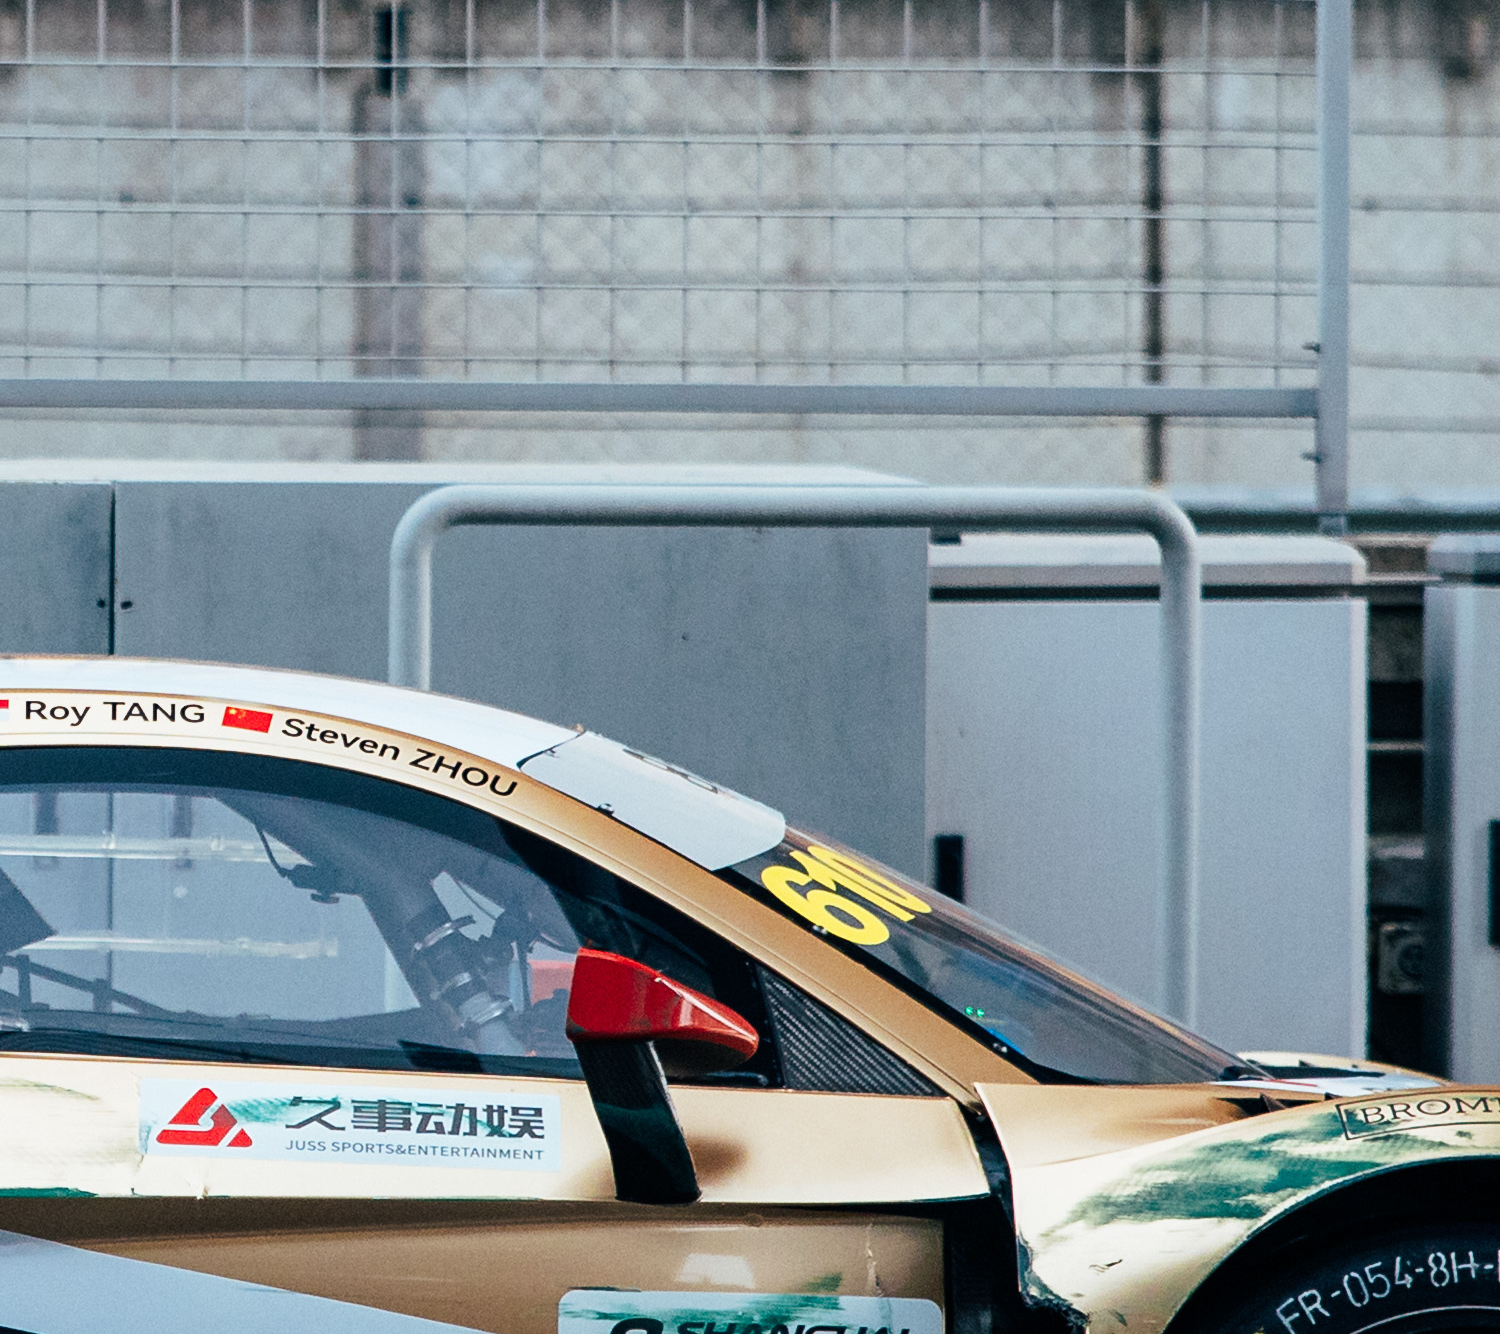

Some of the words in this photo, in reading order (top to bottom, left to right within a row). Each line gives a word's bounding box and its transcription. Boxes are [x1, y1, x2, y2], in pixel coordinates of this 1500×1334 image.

[25, 700, 91, 728] Roy
[103, 701, 206, 724] TANG
[281, 717, 400, 762] Steven
[408, 748, 519, 798] ZHOU
[760, 845, 933, 947] 610
[284, 1096, 545, 1140] 久事动娱
[285, 1139, 328, 1154] JUSS
[330, 1141, 545, 1162] SPORTS&ENTERTAINMENT
